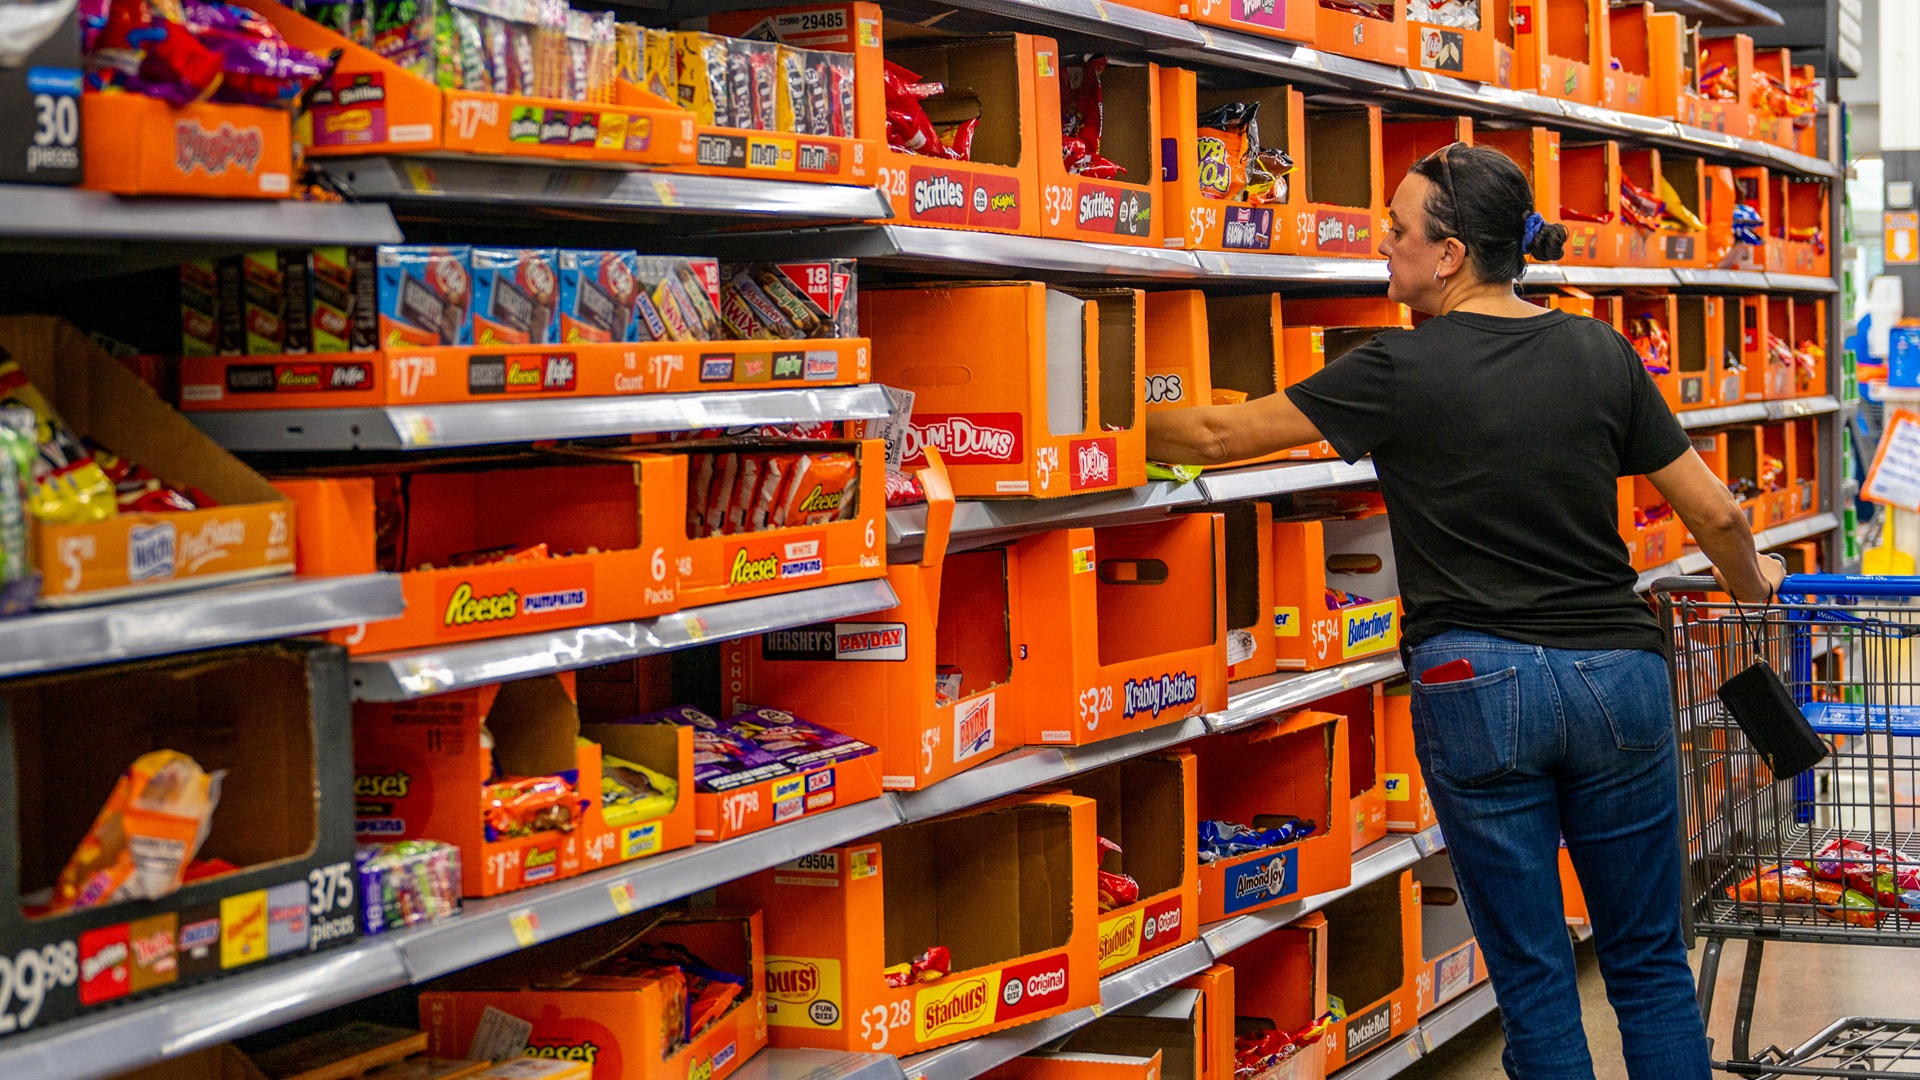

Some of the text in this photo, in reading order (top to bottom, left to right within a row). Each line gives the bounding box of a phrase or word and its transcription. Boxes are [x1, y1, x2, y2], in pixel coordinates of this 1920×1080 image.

[34, 93, 79, 146] 30
[27, 147, 78, 173] pieces
[854, 144, 864, 164] 18
[914, 174, 964, 214] Skittles
[1079, 190, 1114, 224] Skittles
[1274, 218, 1281, 232] 45
[1318, 216, 1342, 245] Skittles
[806, 267, 827, 284] 18
[808, 285, 828, 294] BARS
[856, 347, 867, 368] 18
[615, 372, 643, 391] Count
[865, 519, 875, 548] 6
[792, 544, 812, 556] WHITE
[651, 547, 666, 581] 6
[730, 547, 778, 584] Reese's
[444, 582, 519, 627] Reese's
[645, 588, 674, 604] Packs
[768, 631, 833, 652] HERSHEY'S
[839, 630, 901, 653] PAYDAY
[1347, 612, 1392, 648] Butterfinger
[1124, 672, 1196, 719] Krabby Patties
[960, 702, 989, 752] PAYDAY
[308, 862, 353, 915] 375
[1237, 867, 1284, 897] Almond Joy
[311, 915, 355, 951] pieces
[1159, 910, 1180, 930] Original
[1099, 919, 1136, 960] Starburst
[766, 966, 816, 993] burst
[1008, 983, 1019, 992] FUN
[1029, 971, 1064, 995] Original
[926, 982, 987, 1030] Starburst
[1007, 991, 1020, 1001] SIZE
[522, 1041, 598, 1064] eese's
